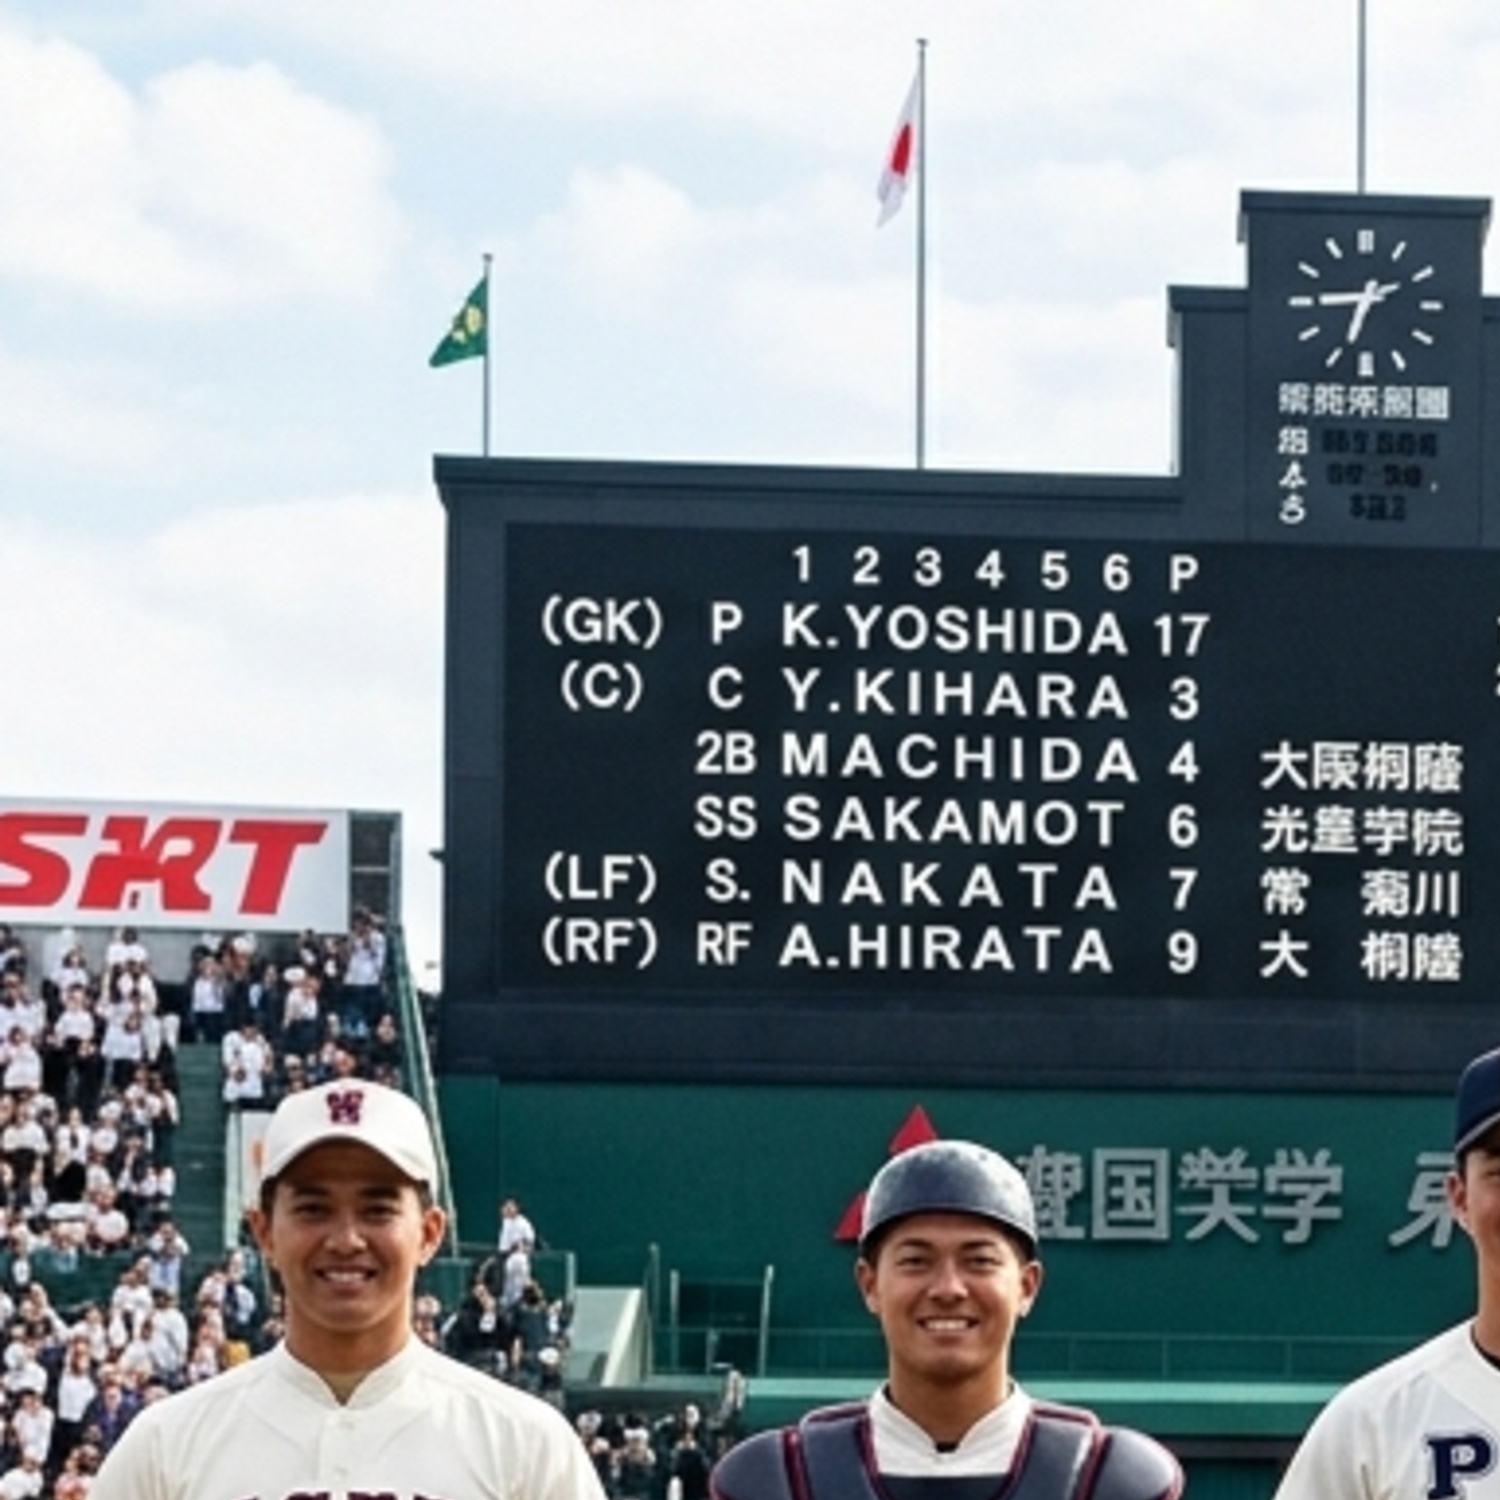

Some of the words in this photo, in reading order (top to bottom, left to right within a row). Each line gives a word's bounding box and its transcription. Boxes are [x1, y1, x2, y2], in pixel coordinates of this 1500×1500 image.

[794, 546, 809, 582] 1
[853, 546, 880, 584] 2
[915, 548, 941, 586] 3
[976, 550, 1005, 588] 4
[1042, 551, 1068, 590] 5
[1104, 554, 1130, 591] 6
[1171, 555, 1198, 592] P
[543, 596, 662, 648] (GK)
[713, 602, 742, 644] P
[783, 603, 1128, 655] K.YOSHIDA
[1155, 615, 1209, 655] 17
[562, 661, 643, 711] (C)
[709, 666, 742, 708] C
[783, 668, 1128, 719] Y.KIHARA
[1170, 677, 1198, 720] 3
[696, 731, 756, 774] 2B
[783, 732, 1139, 783] MACHIDA
[1169, 741, 1199, 783] 4
[695, 795, 757, 838] SS
[785, 796, 1125, 847] SAKAMOT
[1169, 804, 1198, 847] 6
[545, 853, 657, 903] (LF)
[706, 859, 750, 902] S.
[783, 860, 1117, 910] NAKATA
[1170, 869, 1197, 910] 7
[544, 918, 658, 969] (RF)
[698, 922, 752, 965] RF
[779, 925, 1113, 973] A.HIRATA
[1169, 931, 1198, 974] 9
